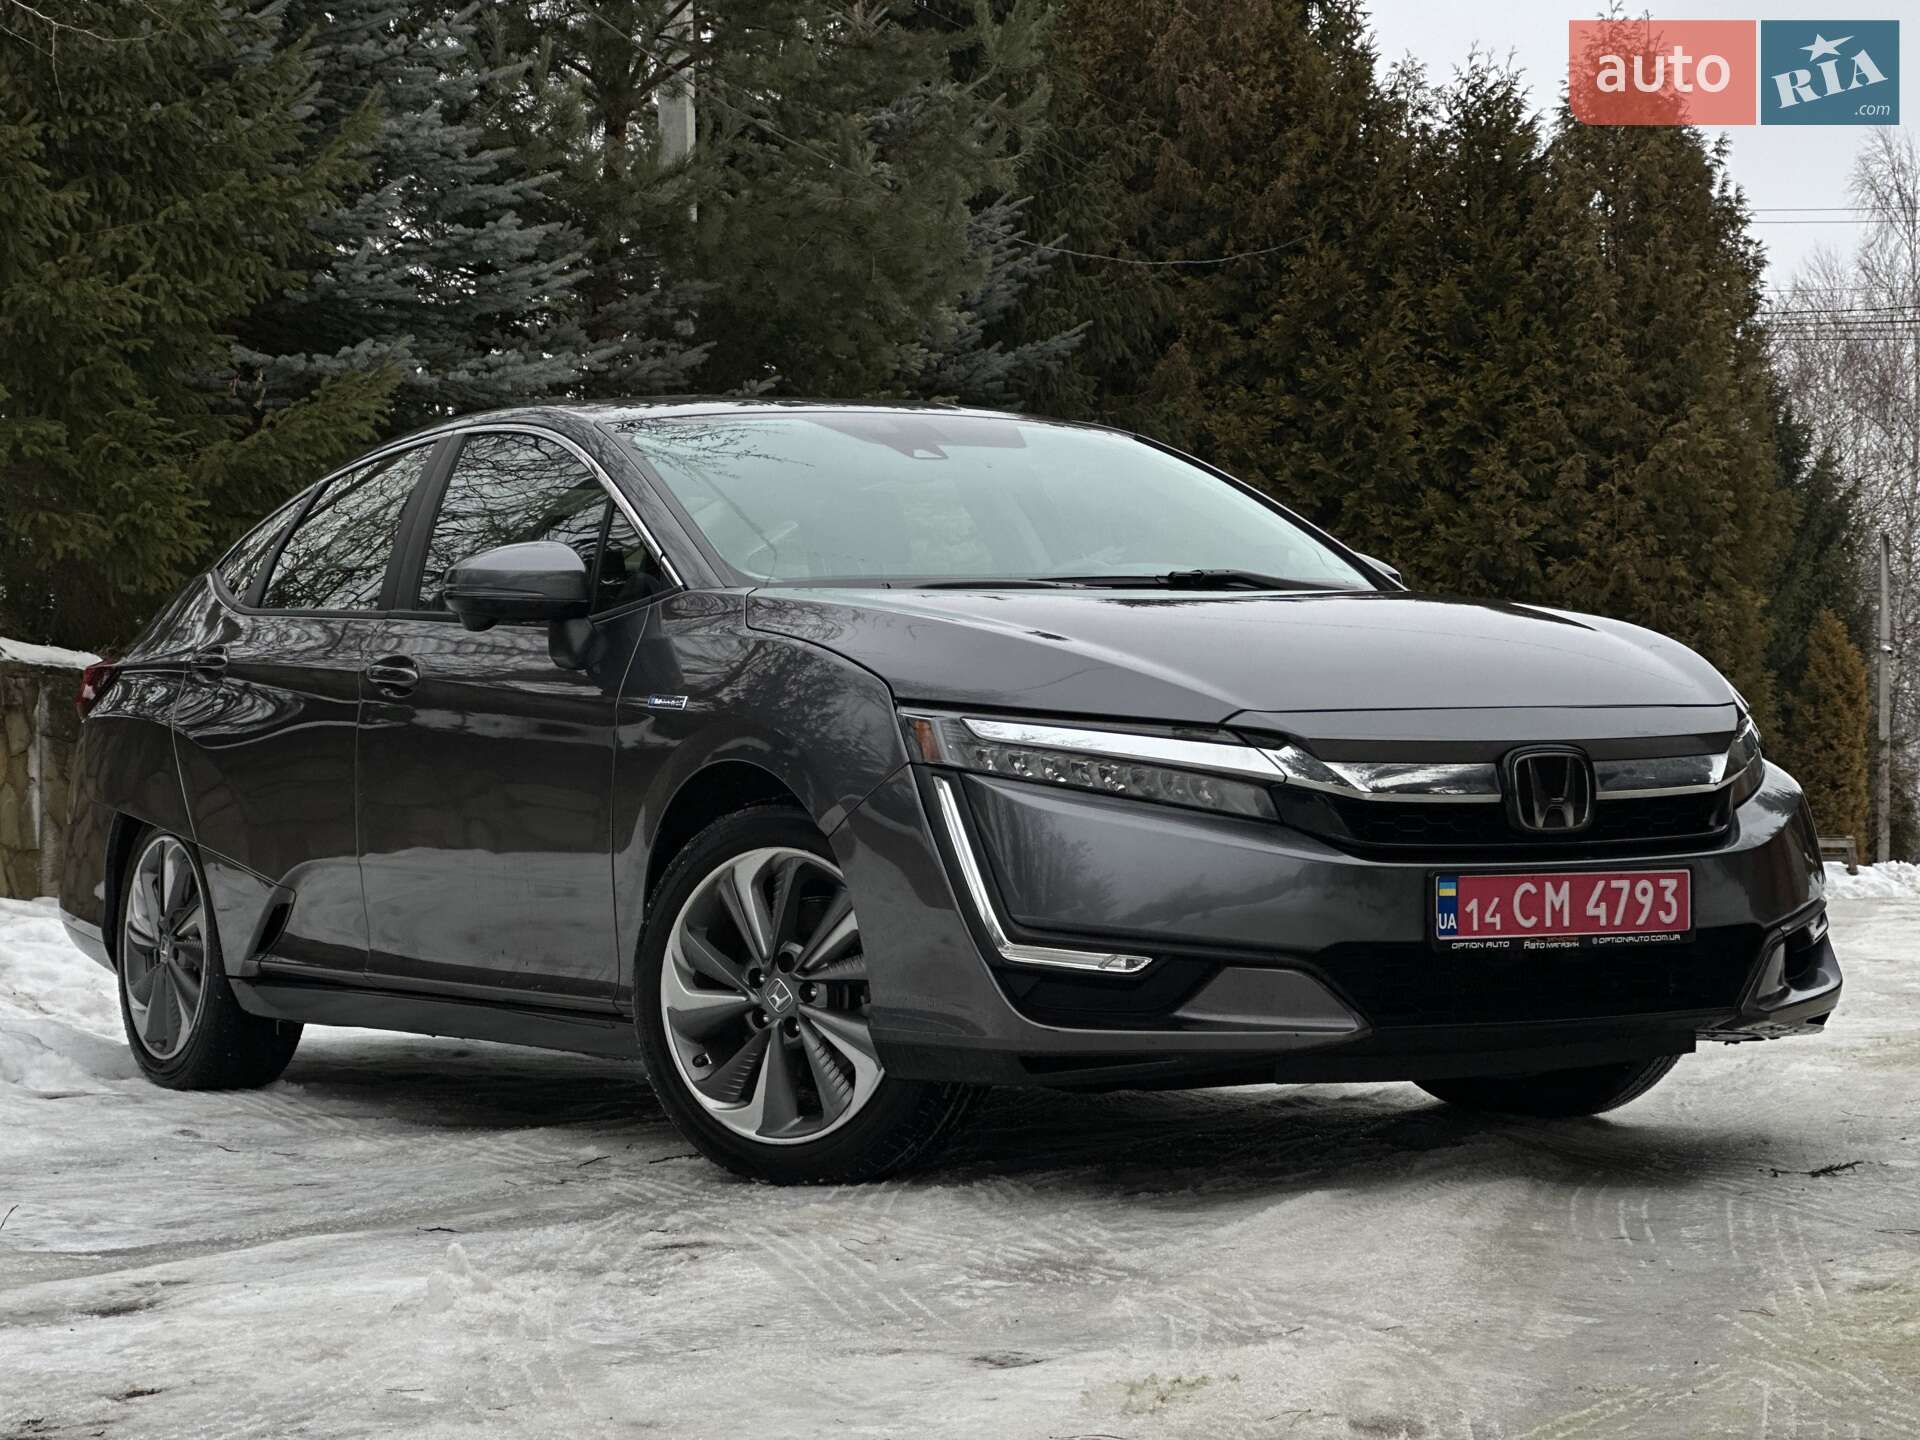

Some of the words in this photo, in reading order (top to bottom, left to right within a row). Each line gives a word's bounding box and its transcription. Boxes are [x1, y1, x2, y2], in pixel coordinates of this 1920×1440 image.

[1465, 897, 1501, 931] 14
[1513, 881, 1570, 928] CM
[1586, 879, 1678, 926] 4793
[1439, 913, 1457, 929] UA
[1451, 942, 1484, 950] OPTION
[1485, 940, 1510, 948] AUTO
